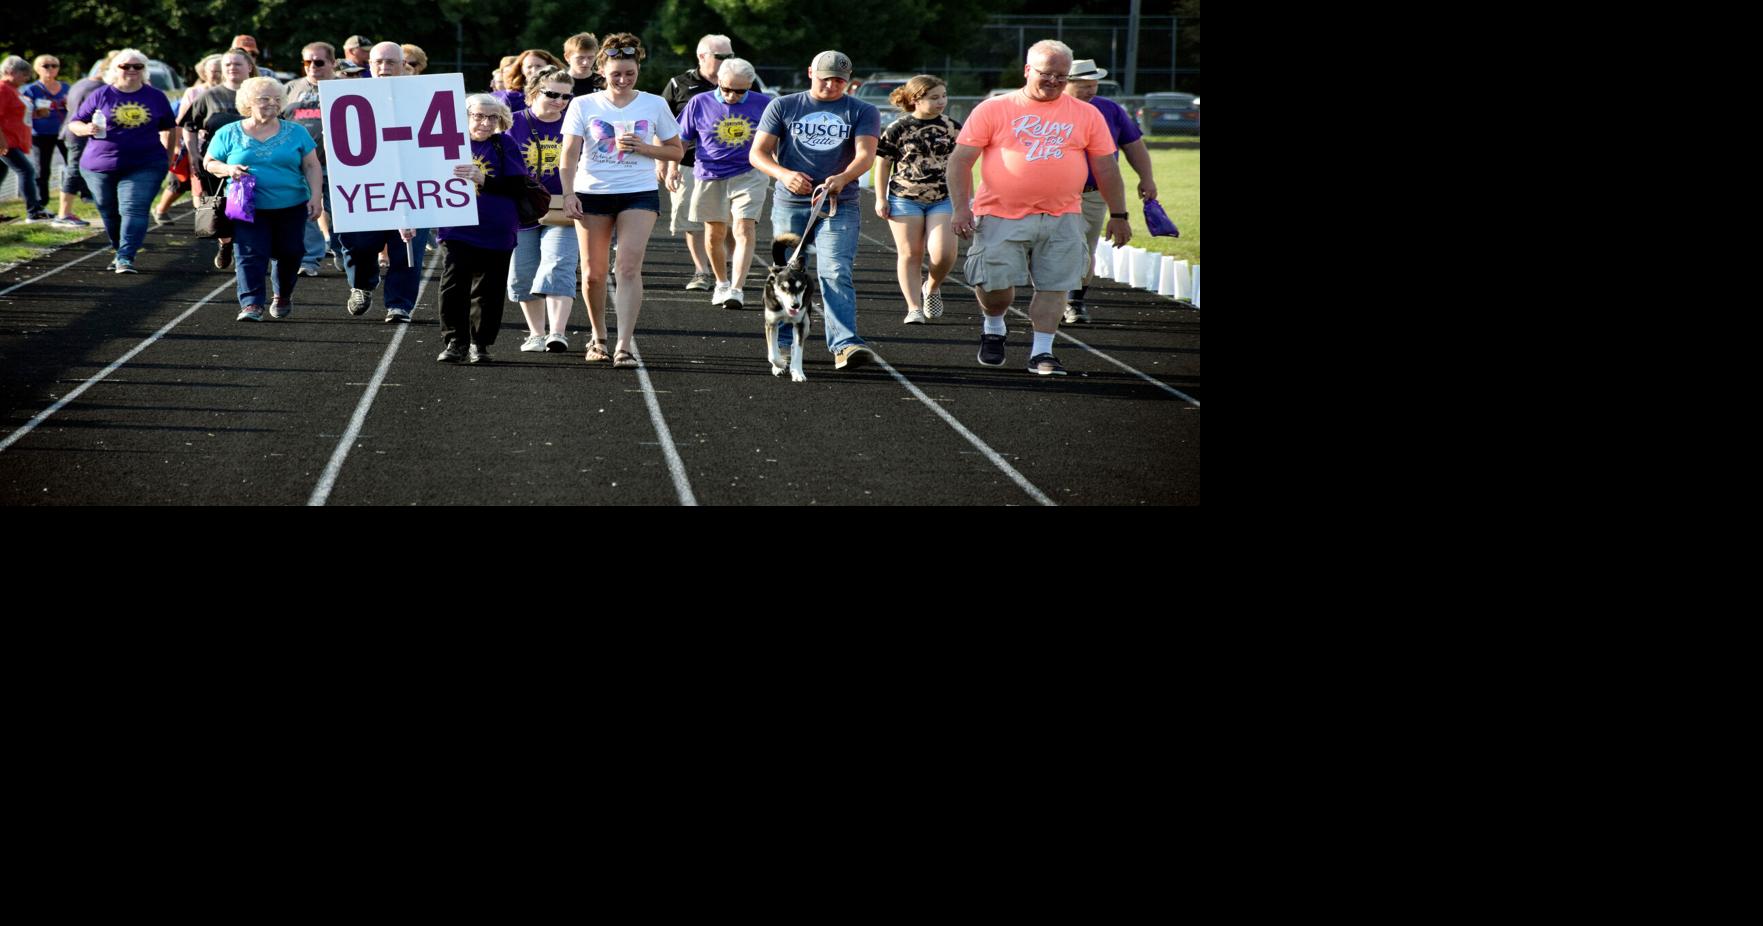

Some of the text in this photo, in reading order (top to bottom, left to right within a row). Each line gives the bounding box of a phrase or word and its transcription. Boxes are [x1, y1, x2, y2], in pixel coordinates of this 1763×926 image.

[329, 89, 465, 167] 0-4
[792, 122, 850, 138] BUSCH
[803, 134, 836, 147] Latte
[336, 177, 471, 214] YEARS
